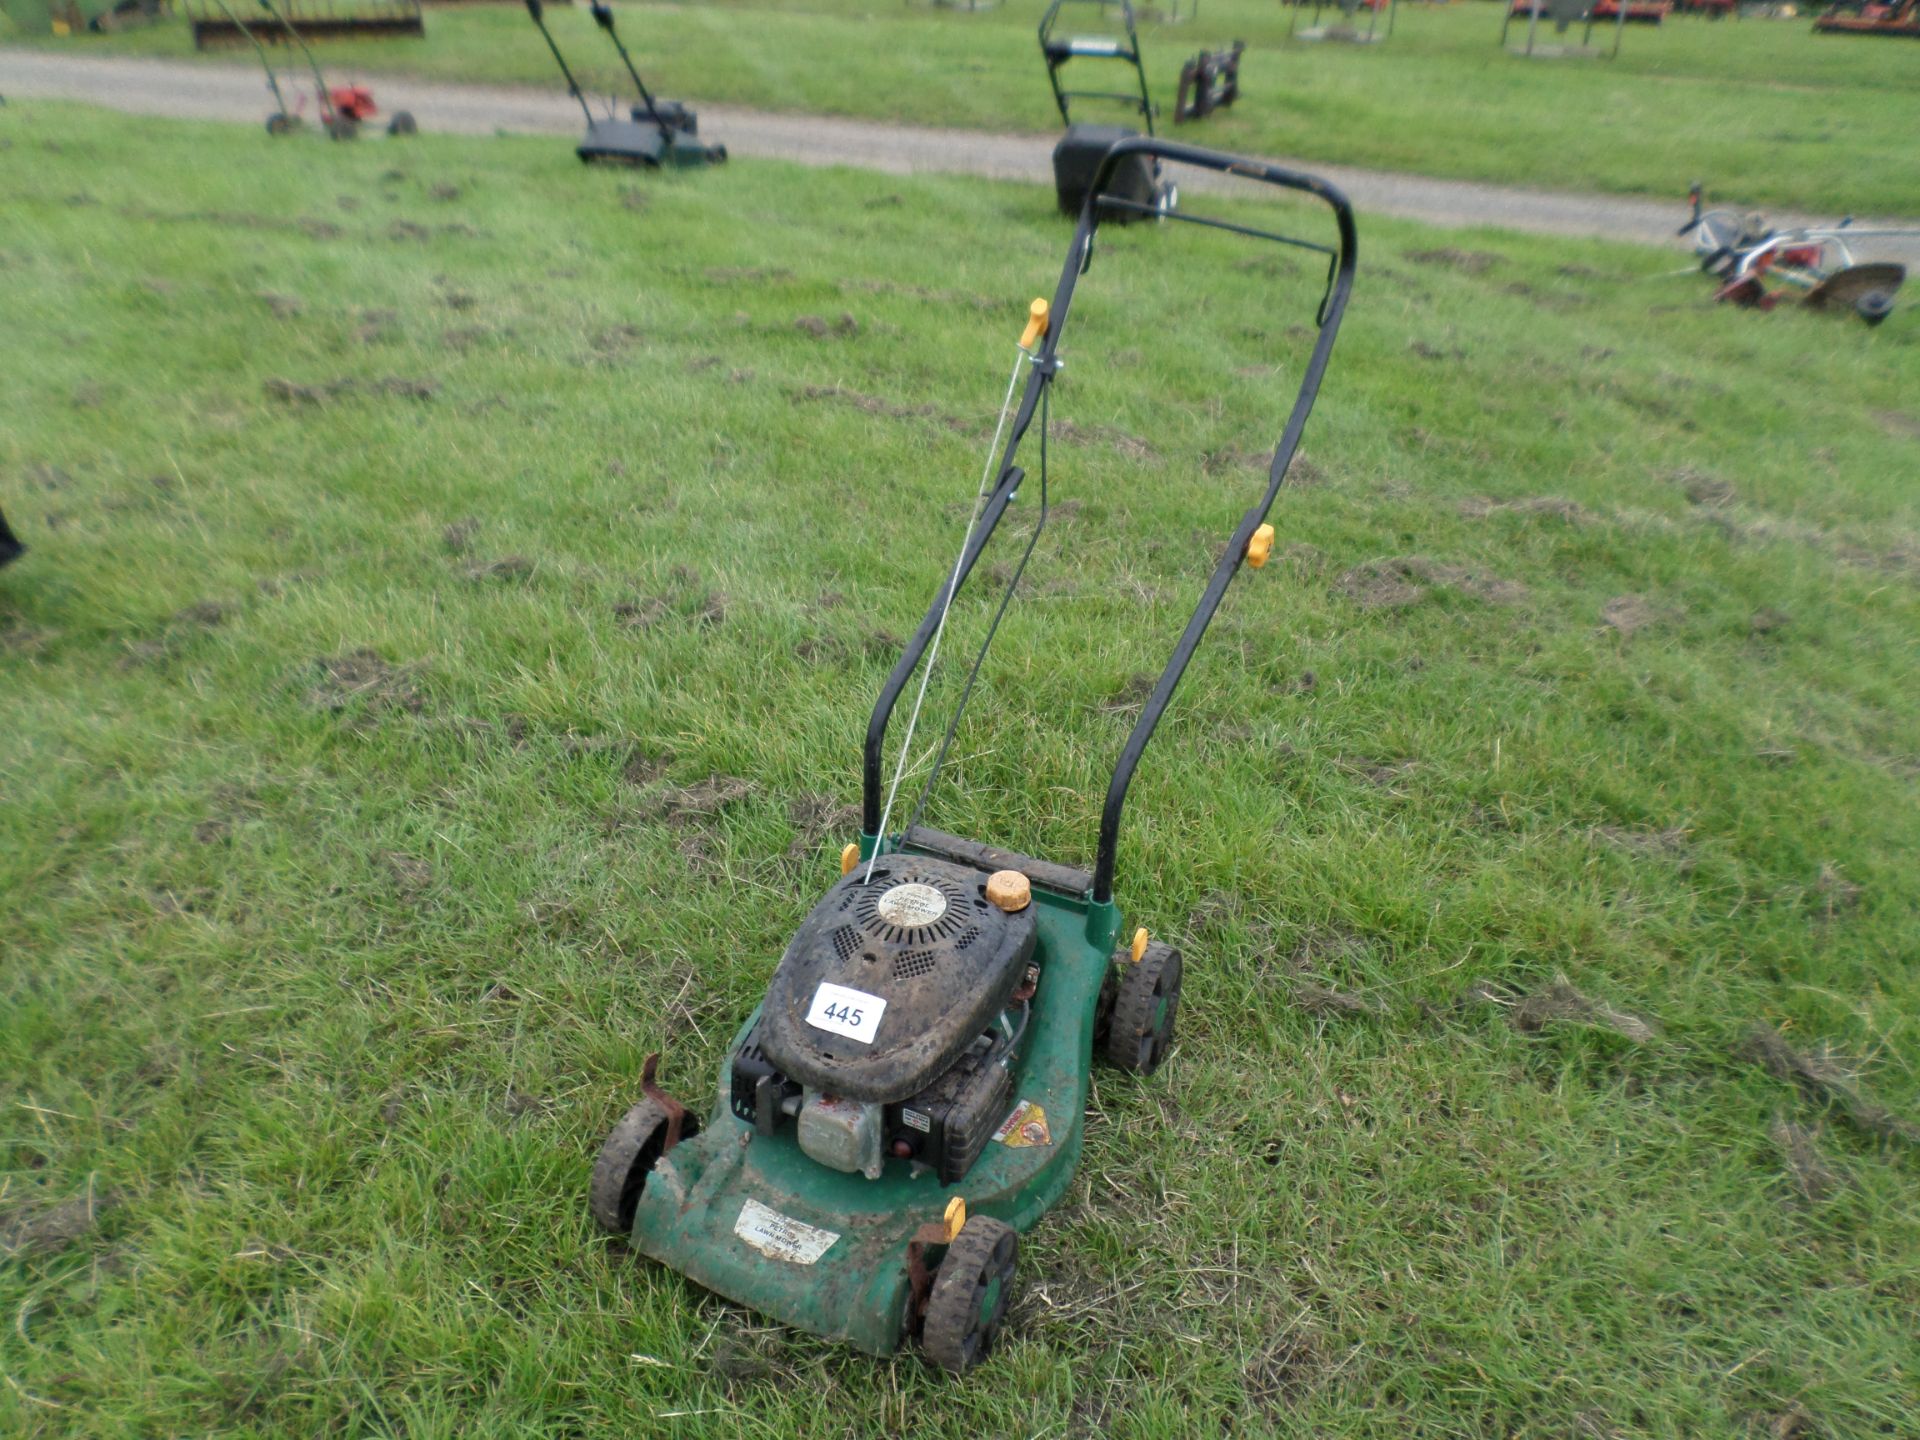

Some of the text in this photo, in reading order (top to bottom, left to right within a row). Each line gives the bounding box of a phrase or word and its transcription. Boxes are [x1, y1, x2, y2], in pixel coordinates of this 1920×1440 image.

[824, 1002, 864, 1026] 445
[754, 1226, 774, 1238] LAWN
[774, 1235, 802, 1250] MOWER
[769, 1222, 796, 1239] PETROL
